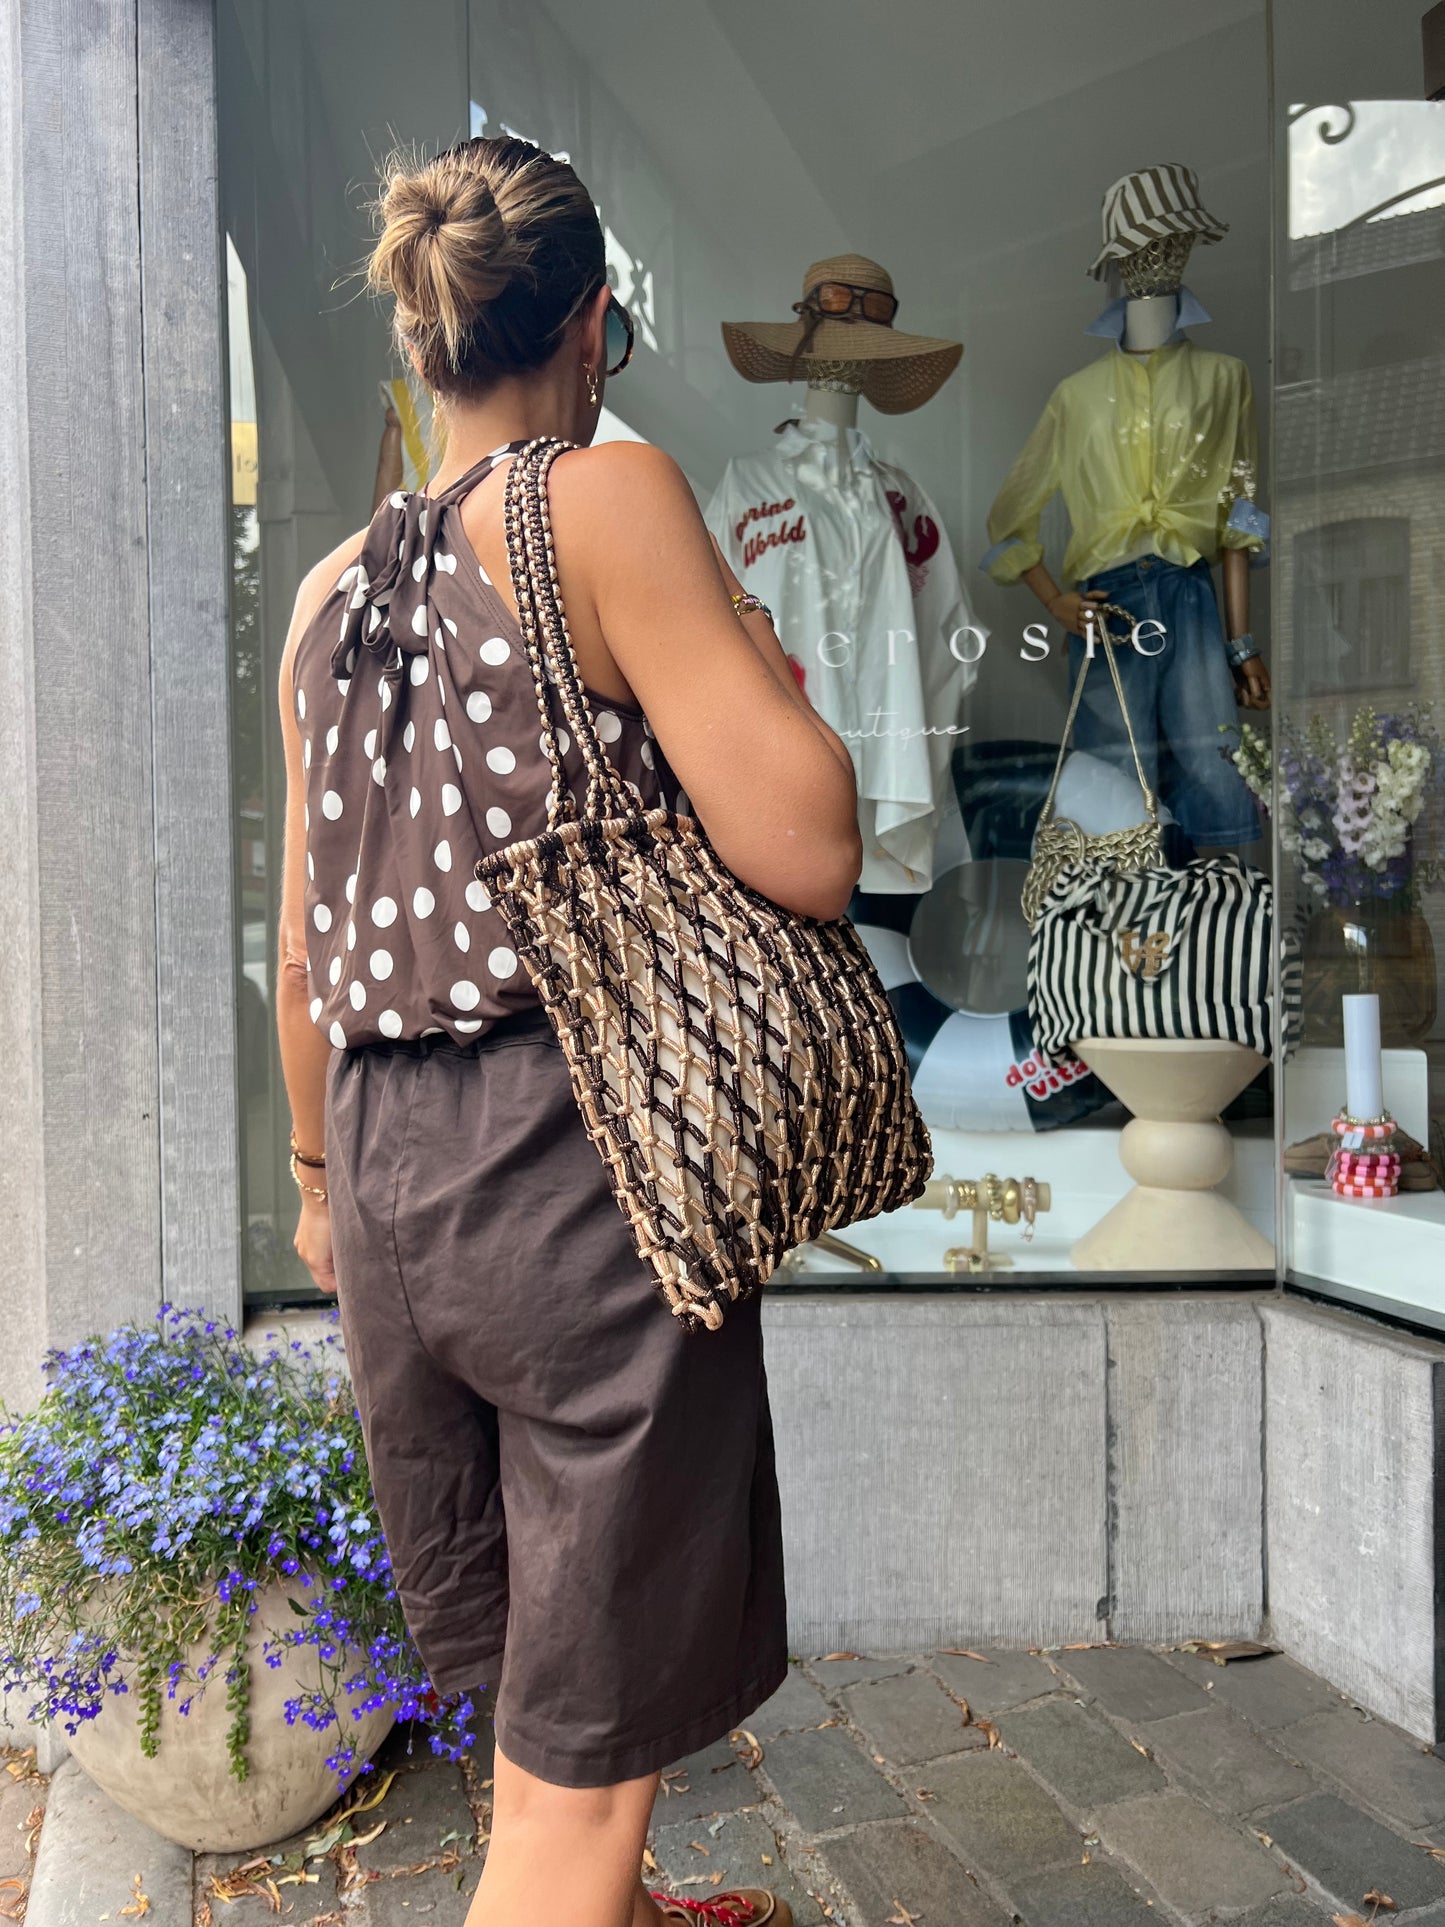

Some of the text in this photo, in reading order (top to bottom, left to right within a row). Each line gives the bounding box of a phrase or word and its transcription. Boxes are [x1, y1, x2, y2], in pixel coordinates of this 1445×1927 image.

[743, 515, 806, 569] World
[774, 609, 1168, 669] erosie
[839, 706, 970, 751] utique
